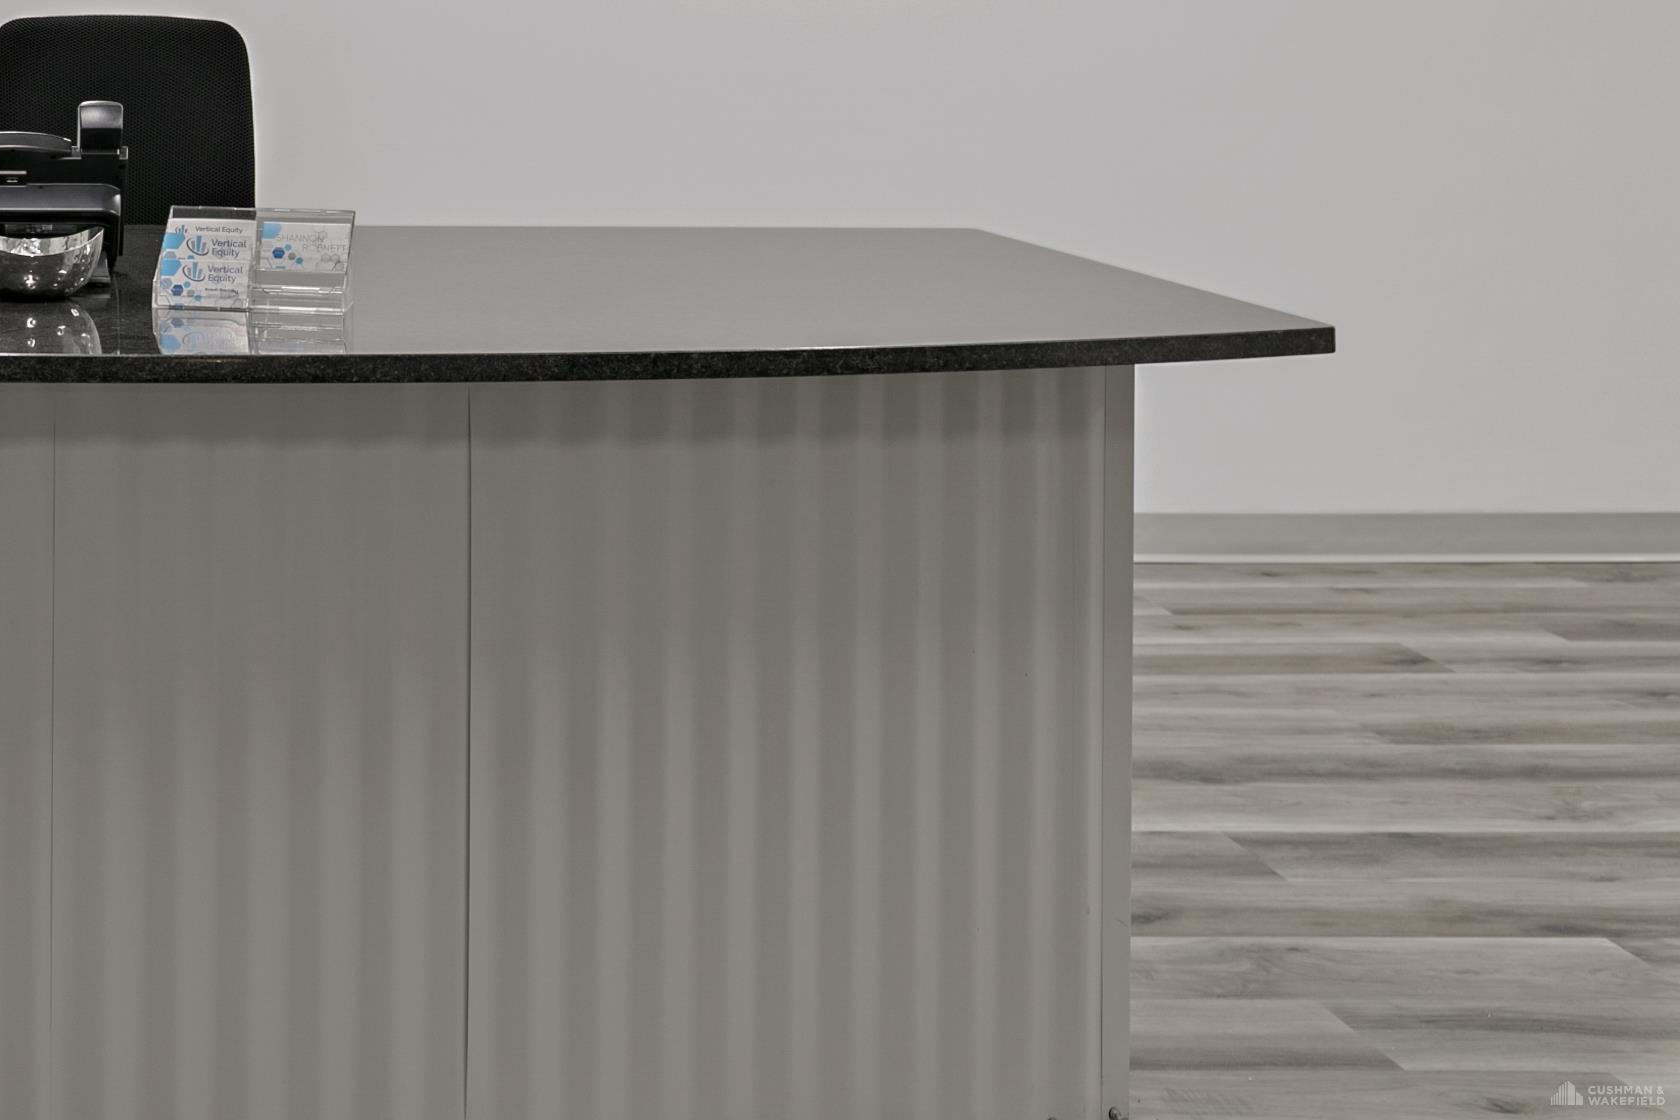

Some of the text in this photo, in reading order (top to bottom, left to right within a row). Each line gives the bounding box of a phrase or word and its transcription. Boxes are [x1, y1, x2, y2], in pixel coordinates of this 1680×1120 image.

[222, 226, 242, 234] Equity
[211, 239, 247, 248] Vertical
[212, 248, 240, 257] Equity
[208, 265, 243, 274] Vertical
[208, 274, 237, 284] Equity
